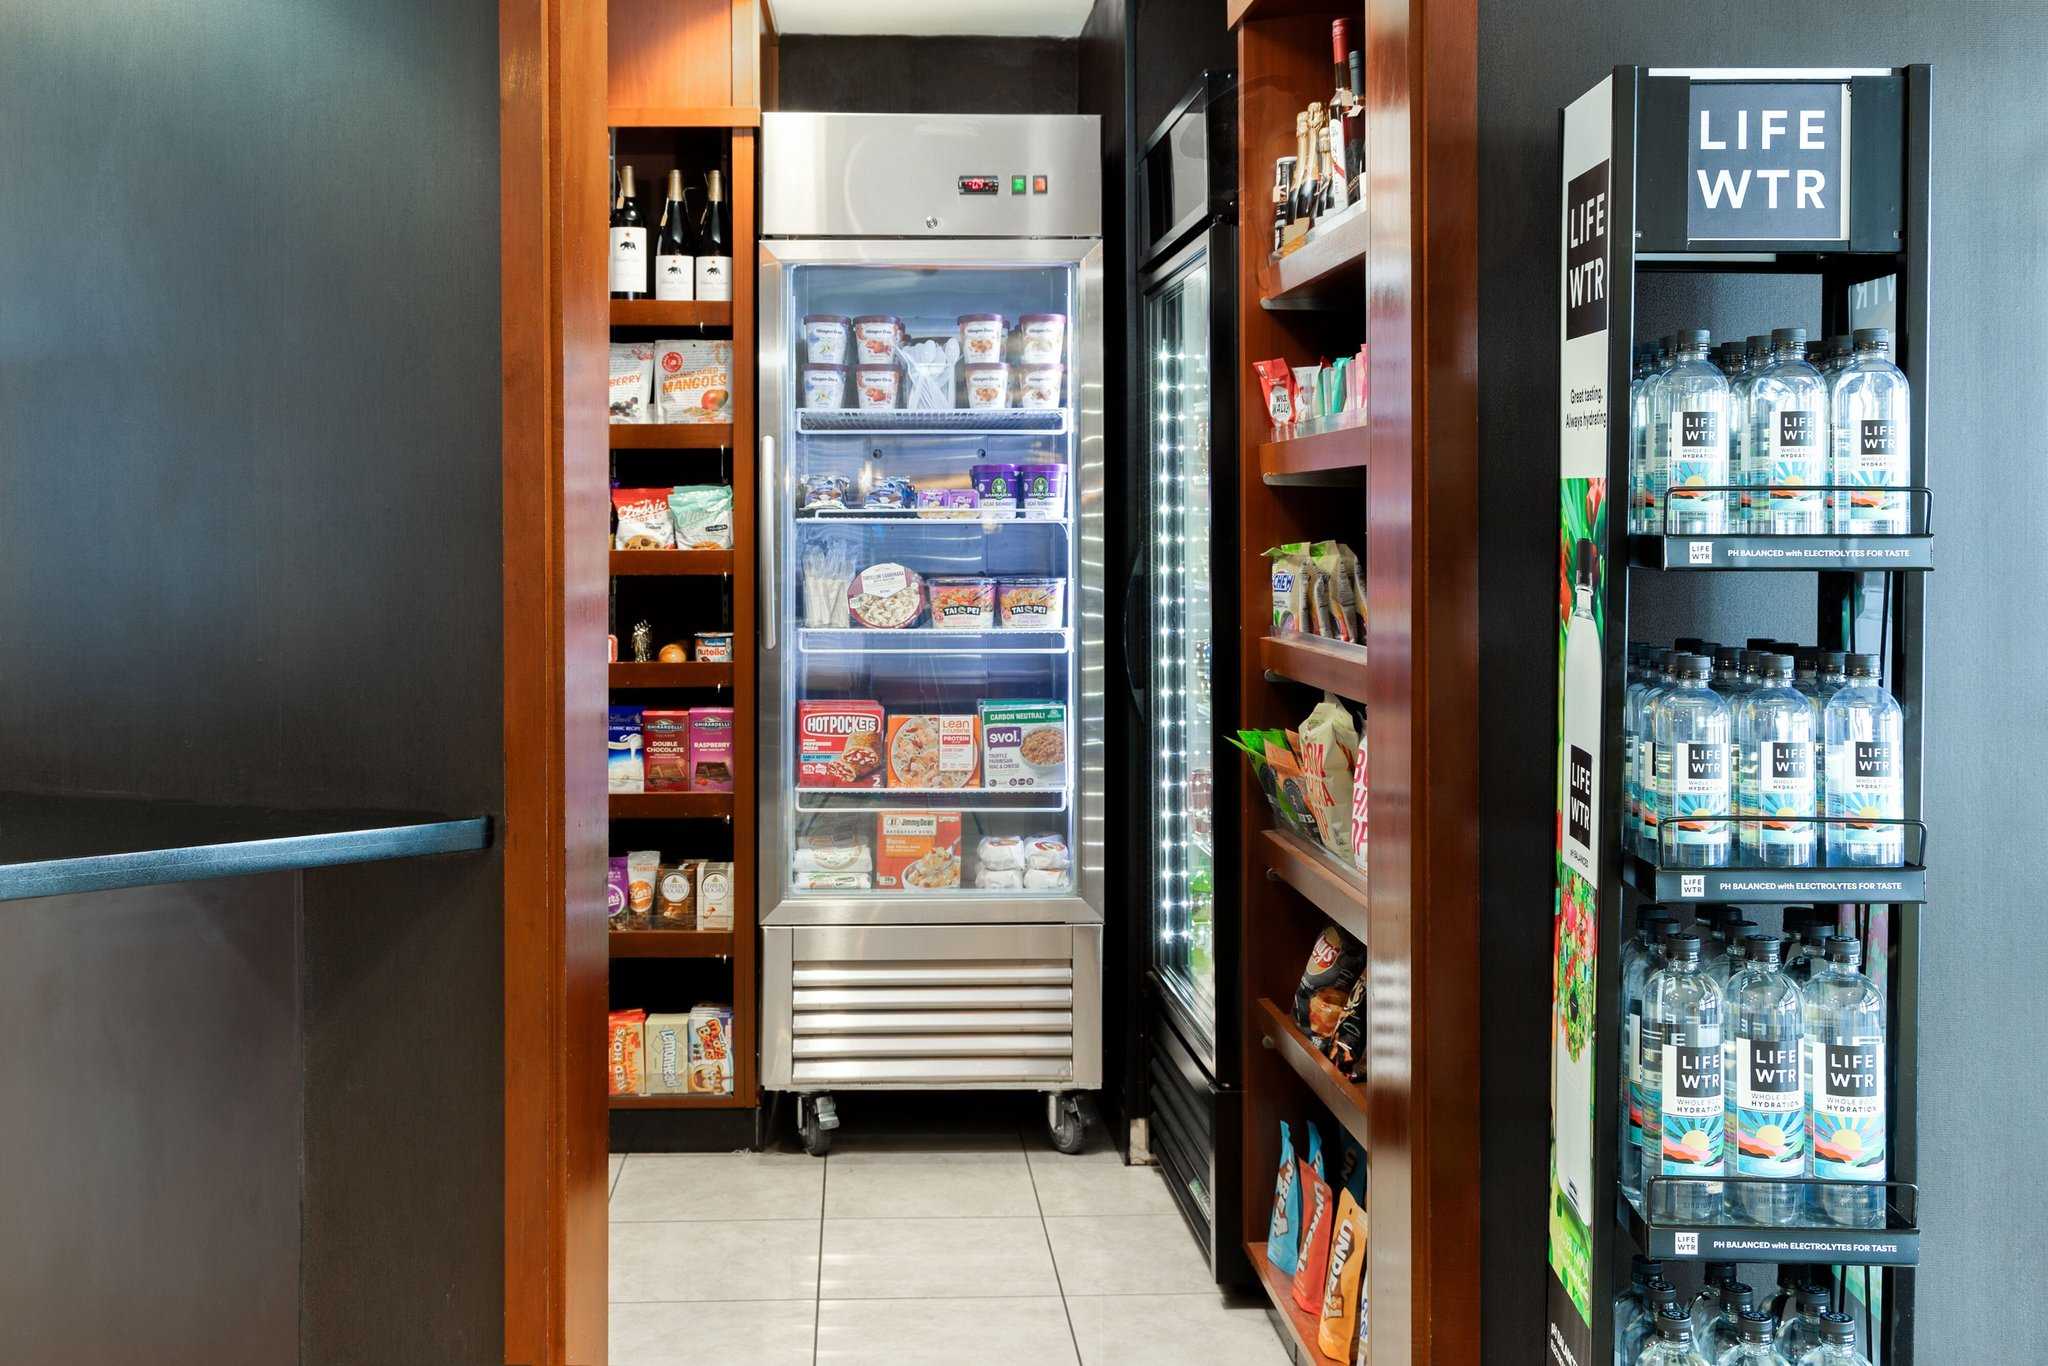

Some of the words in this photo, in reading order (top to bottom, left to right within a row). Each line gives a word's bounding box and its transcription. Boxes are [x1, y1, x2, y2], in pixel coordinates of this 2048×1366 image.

[1700, 110, 1826, 150] LIFE
[1697, 169, 1826, 209] WTR
[1570, 192, 1605, 249] LIFE
[1569, 257, 1605, 309] WTR
[662, 374, 727, 395] MANGOES
[1686, 417, 1716, 428] LIFE
[1784, 417, 1814, 427] LIFE
[1686, 430, 1716, 441] WTR
[1784, 430, 1814, 440] WTR
[1864, 425, 1896, 436] LIFE
[1864, 438, 1896, 449] WTR
[1727, 549, 1739, 557] PH
[1740, 549, 1784, 557] BALANCED
[1785, 549, 1802, 557] with
[1803, 549, 1865, 557] ELECTROLYTES
[1866, 549, 1884, 557] FOR
[1884, 549, 1910, 557] TASTE
[945, 607, 957, 615] TAI
[967, 607, 979, 615] PEI
[1012, 606, 1024, 614] TAI
[1033, 606, 1046, 614] PEI
[990, 713, 1014, 721] CARBON
[943, 719, 969, 729] Lean
[989, 730, 1020, 743] evol.
[1691, 750, 1721, 760] LIFE
[1776, 748, 1806, 759] LIFE
[1859, 747, 1889, 758] LIFE
[1691, 763, 1721, 773] WTR
[1776, 761, 1806, 772] WTR
[1858, 760, 1889, 771] WTR
[872, 777, 881, 787] 2
[1571, 762, 1591, 795] LIFE
[1571, 796, 1590, 831] WTR
[1720, 882, 1731, 890] PH
[1732, 882, 1776, 890] BALANCED
[1777, 882, 1795, 890] with
[1796, 882, 1858, 890] ELECTROLYTES
[1858, 882, 1876, 890] FOR
[1877, 882, 1903, 890] TASTE
[614, 1027, 626, 1061] HOTS
[1682, 1053, 1720, 1070] LIFE
[1756, 1049, 1797, 1064] LIFE
[1831, 1053, 1874, 1069] LIFE
[614, 1065, 627, 1090] RED
[1755, 1068, 1797, 1083] WTR
[1830, 1072, 1874, 1089] WTR
[1681, 1073, 1720, 1090] WTR
[1713, 1240, 1725, 1249] PH
[1726, 1241, 1770, 1249] BALANCED
[1771, 1242, 1789, 1250] with
[1790, 1242, 1852, 1252] ELECTROLYTES
[1853, 1244, 1870, 1252] FOR
[1871, 1245, 1897, 1253] TASTE
